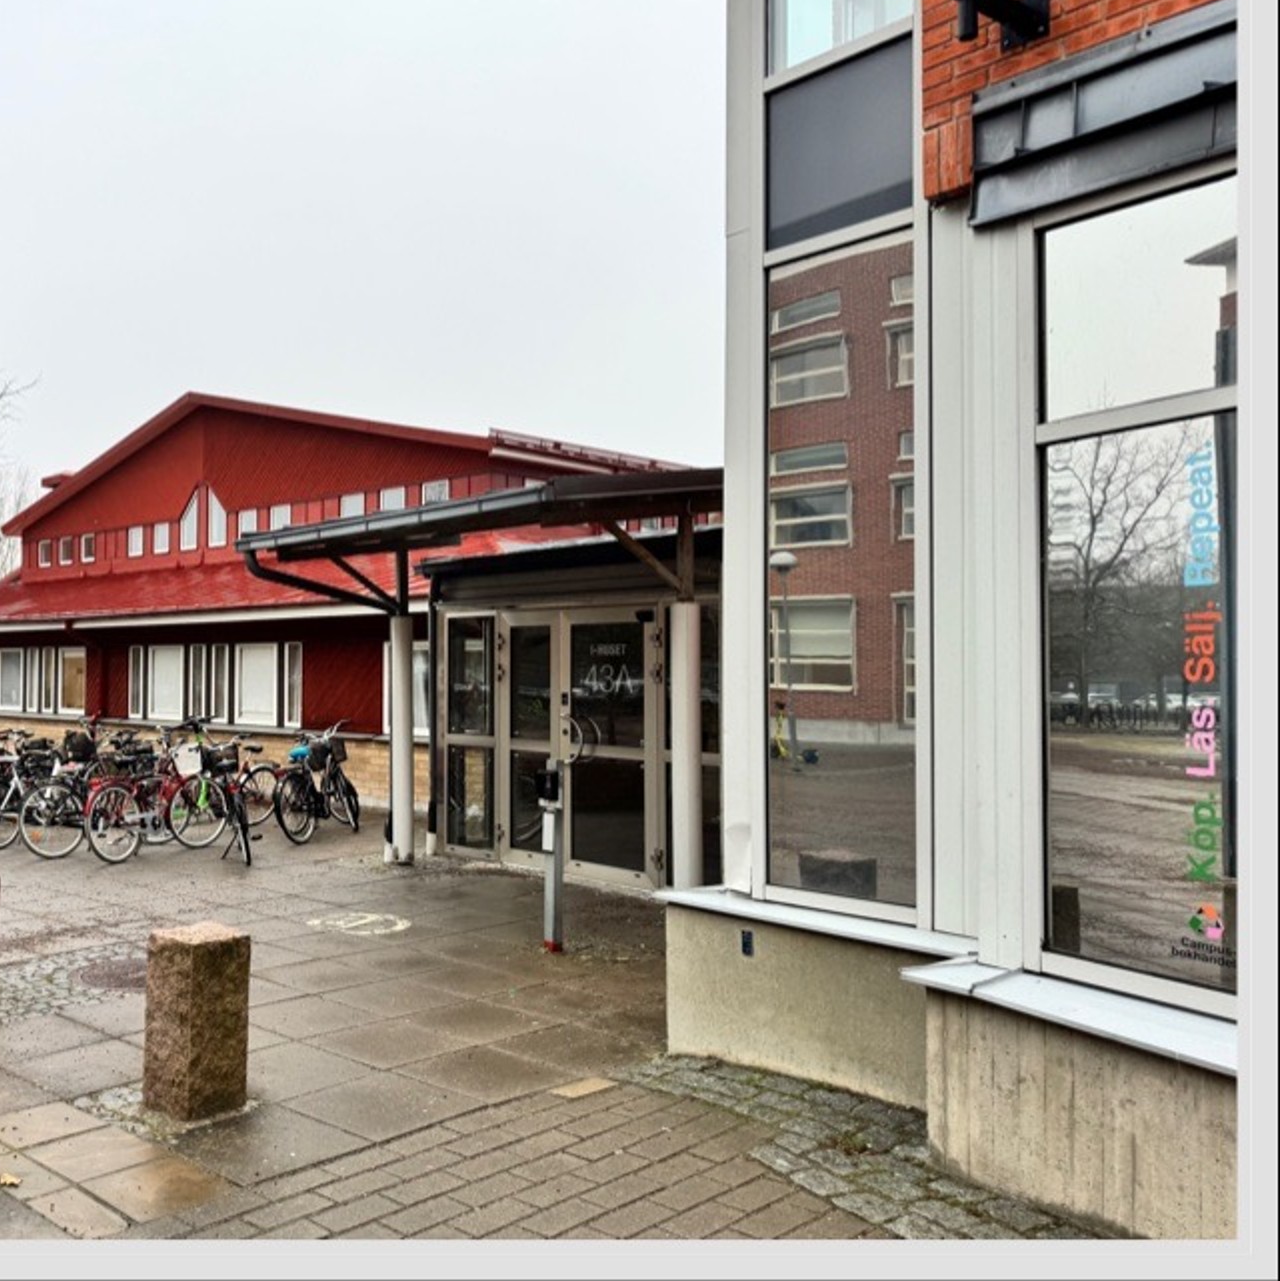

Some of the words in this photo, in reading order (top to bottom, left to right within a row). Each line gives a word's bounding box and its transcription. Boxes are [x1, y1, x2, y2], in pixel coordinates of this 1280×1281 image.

[1183, 439, 1220, 587] Repeat.
[584, 664, 633, 694] 43A
[1183, 600, 1222, 684] Sälj.
[1186, 696, 1216, 776] Läs.
[1185, 792, 1223, 882] Köp.
